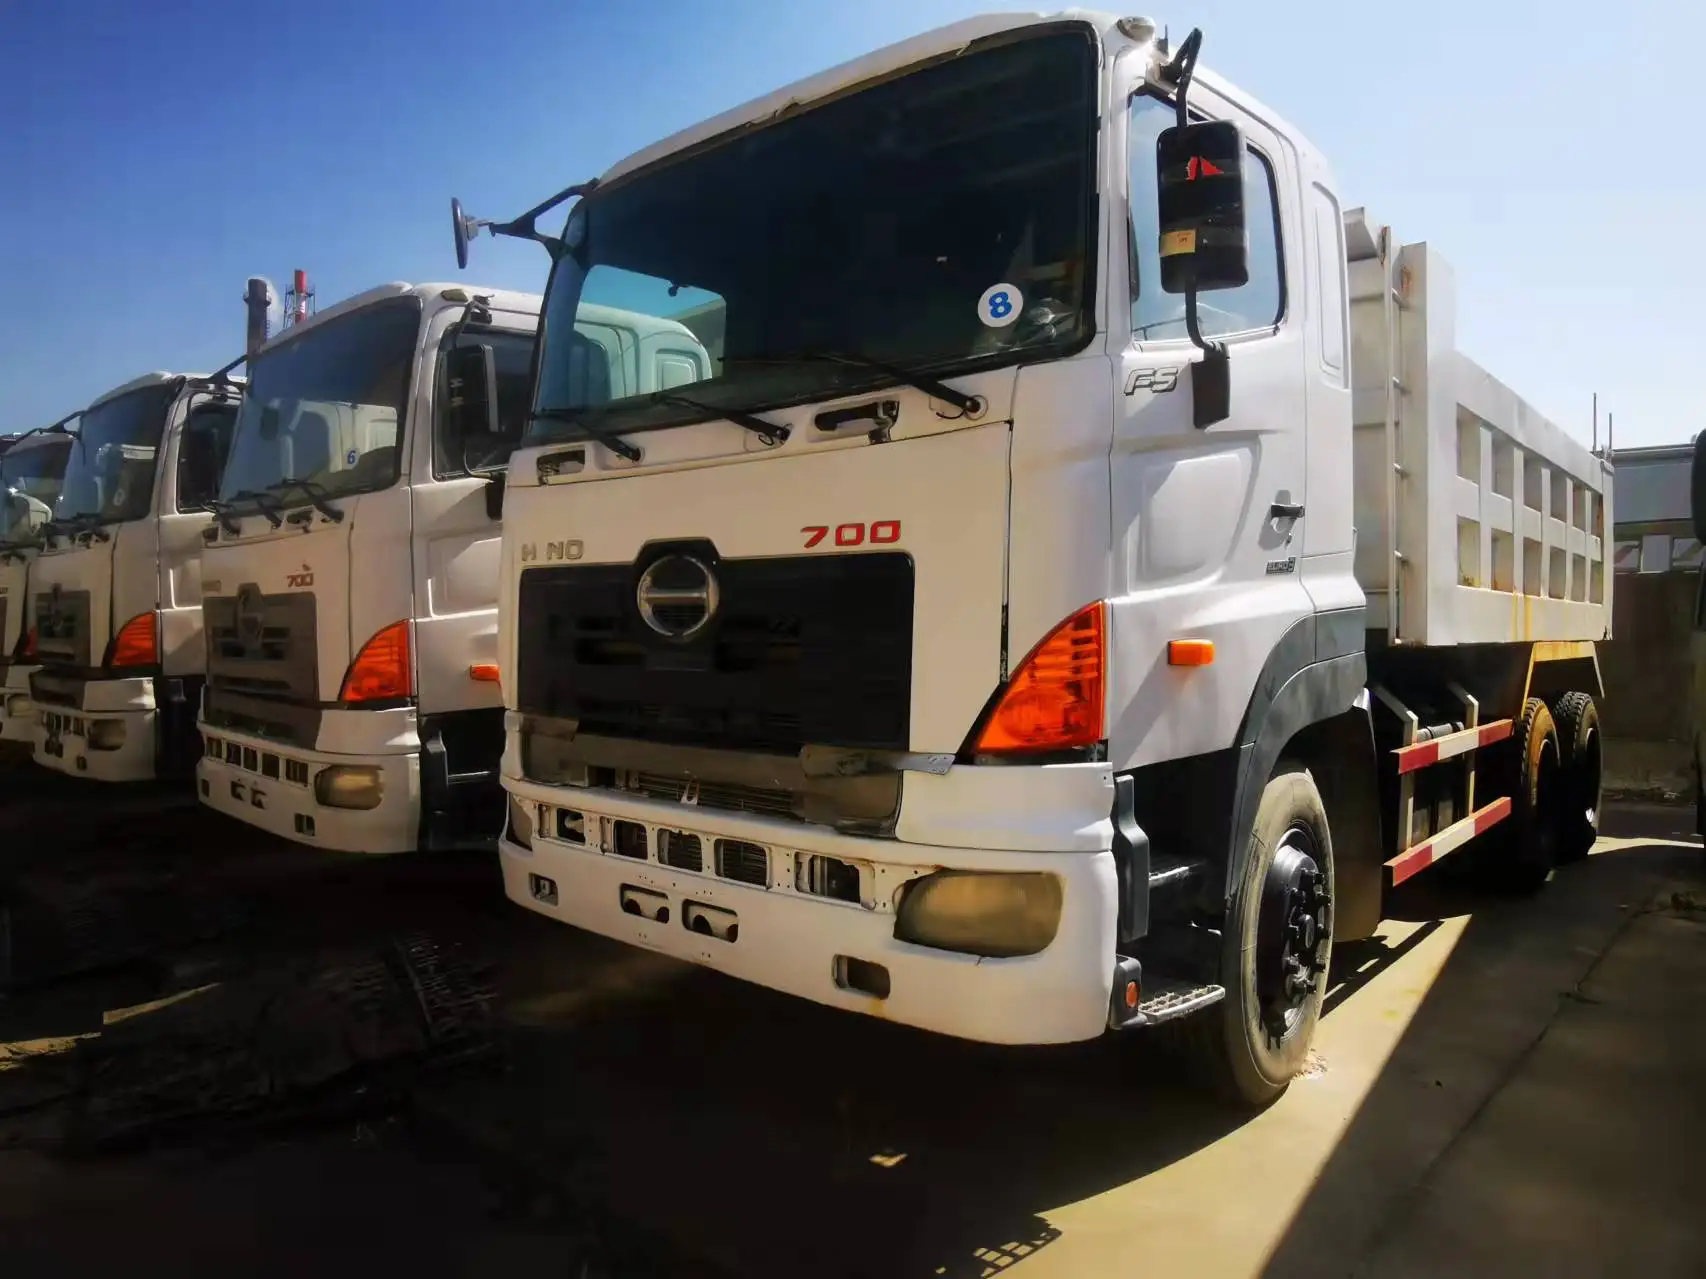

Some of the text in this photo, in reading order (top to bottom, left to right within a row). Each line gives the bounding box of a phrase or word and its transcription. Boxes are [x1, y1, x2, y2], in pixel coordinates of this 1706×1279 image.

[988, 291, 1012, 318] 8
[1124, 367, 1178, 396] FS
[347, 450, 356, 464] 6
[801, 520, 901, 549] 700
[287, 573, 314, 588] 700
